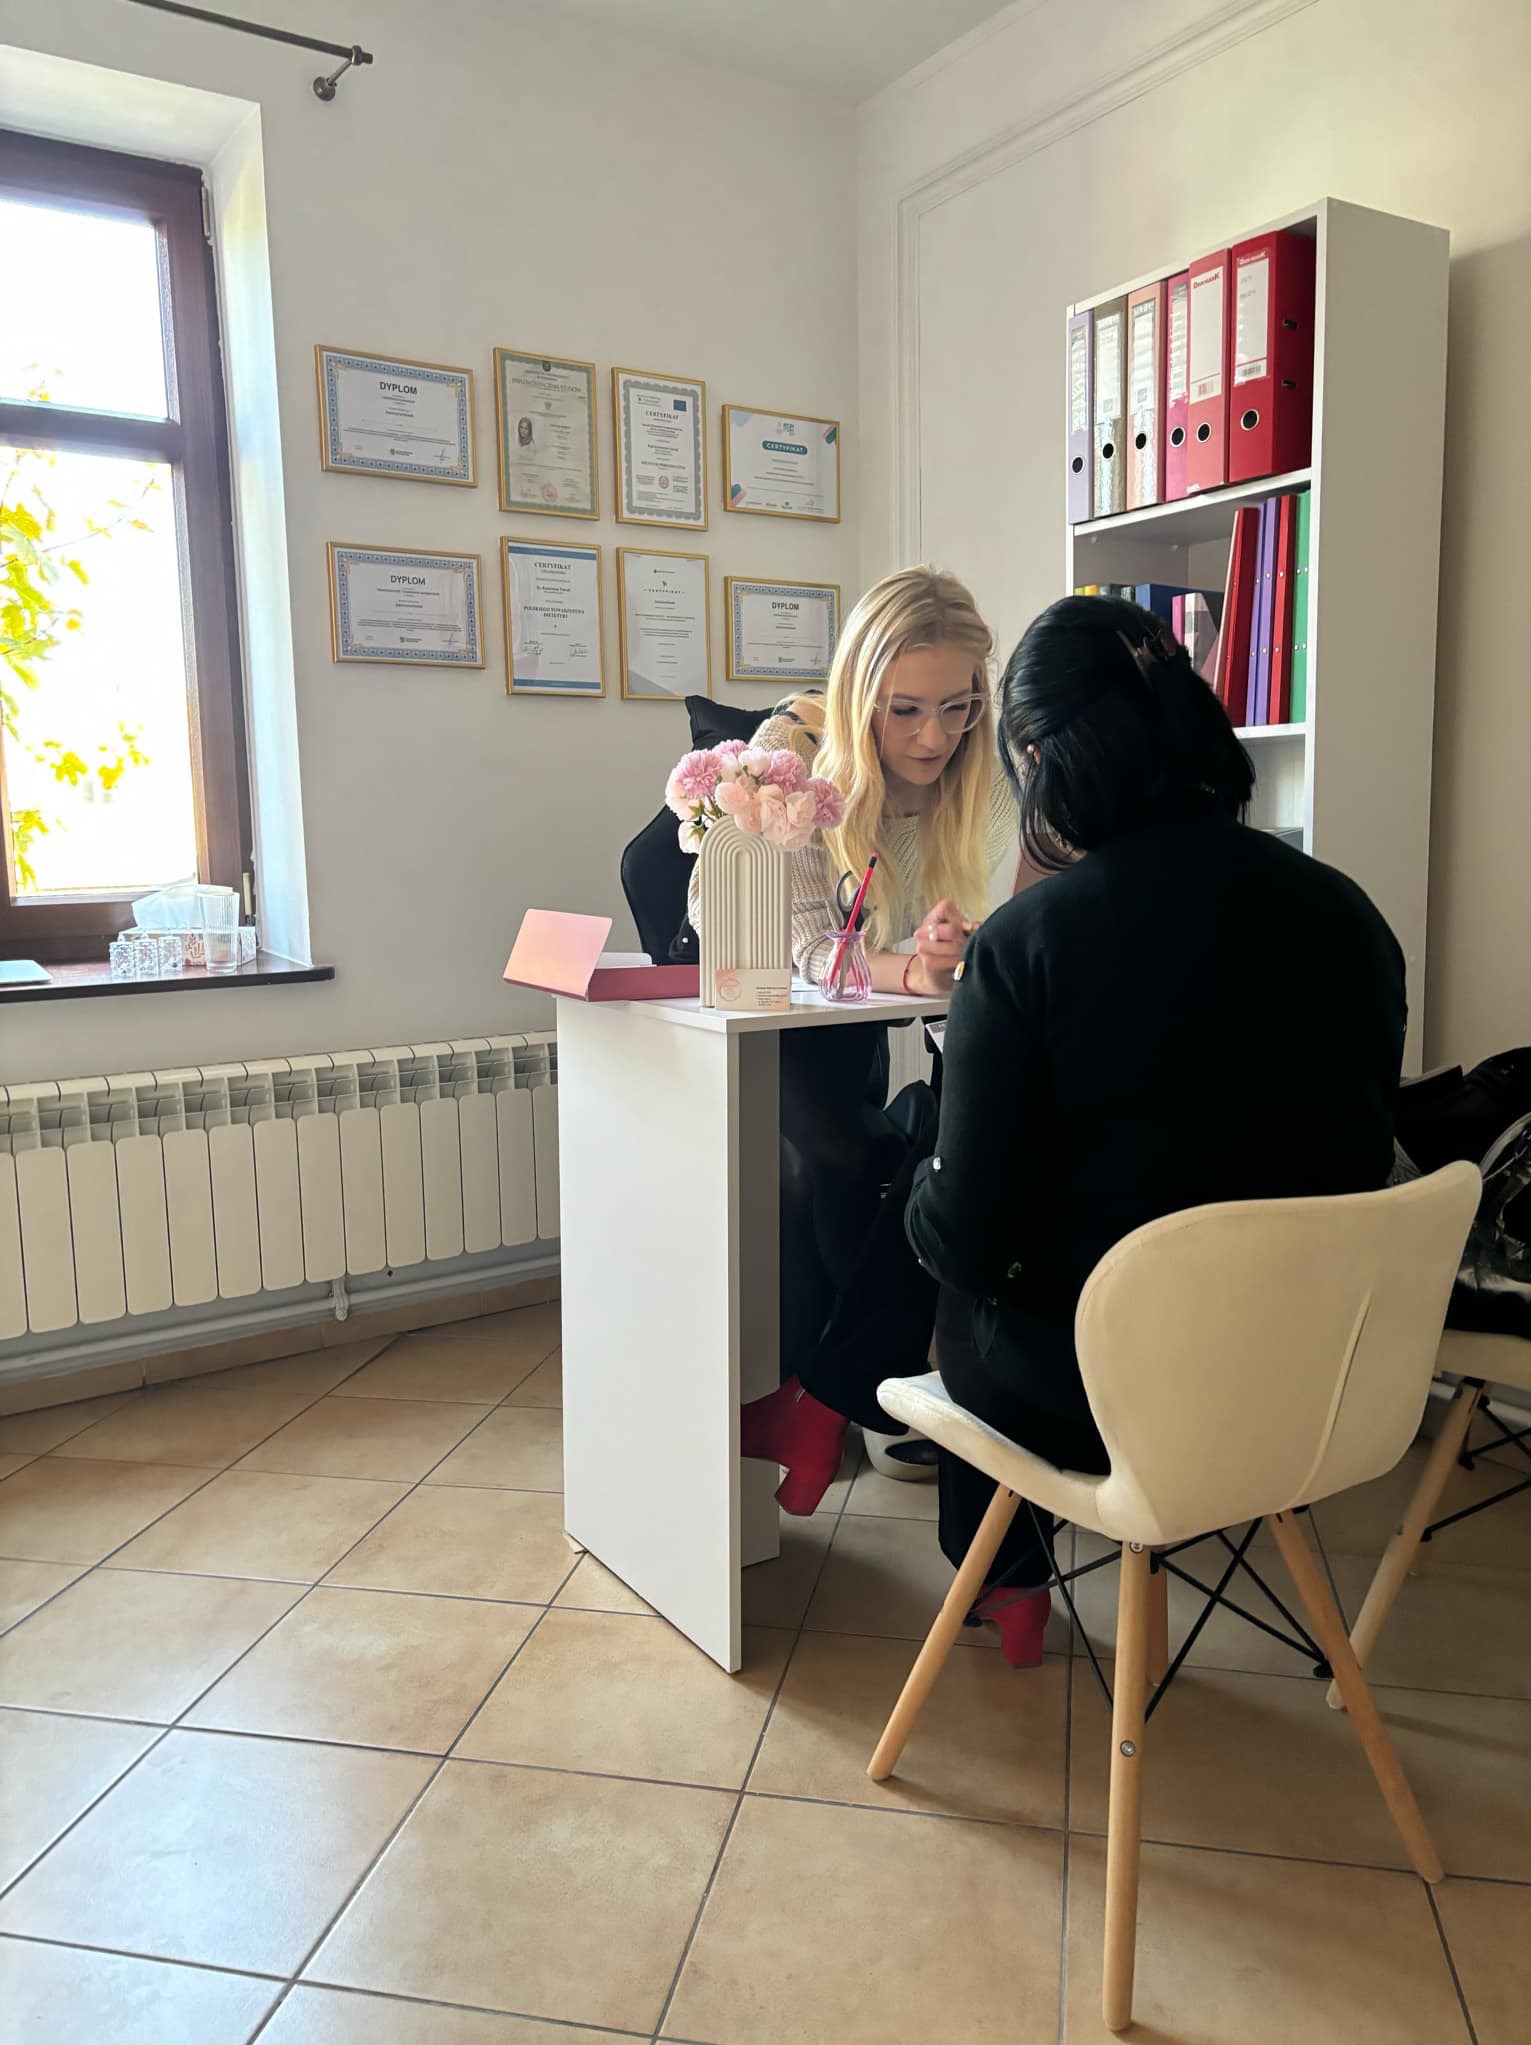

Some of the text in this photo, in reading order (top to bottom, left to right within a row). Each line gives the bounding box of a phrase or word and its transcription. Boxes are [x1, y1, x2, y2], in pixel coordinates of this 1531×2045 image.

[379, 381, 418, 395] DYPLOM
[766, 442, 804, 454] CERTYFIKAT
[390, 575, 426, 585] DYPLOM
[771, 601, 800, 611] DYPLOM
